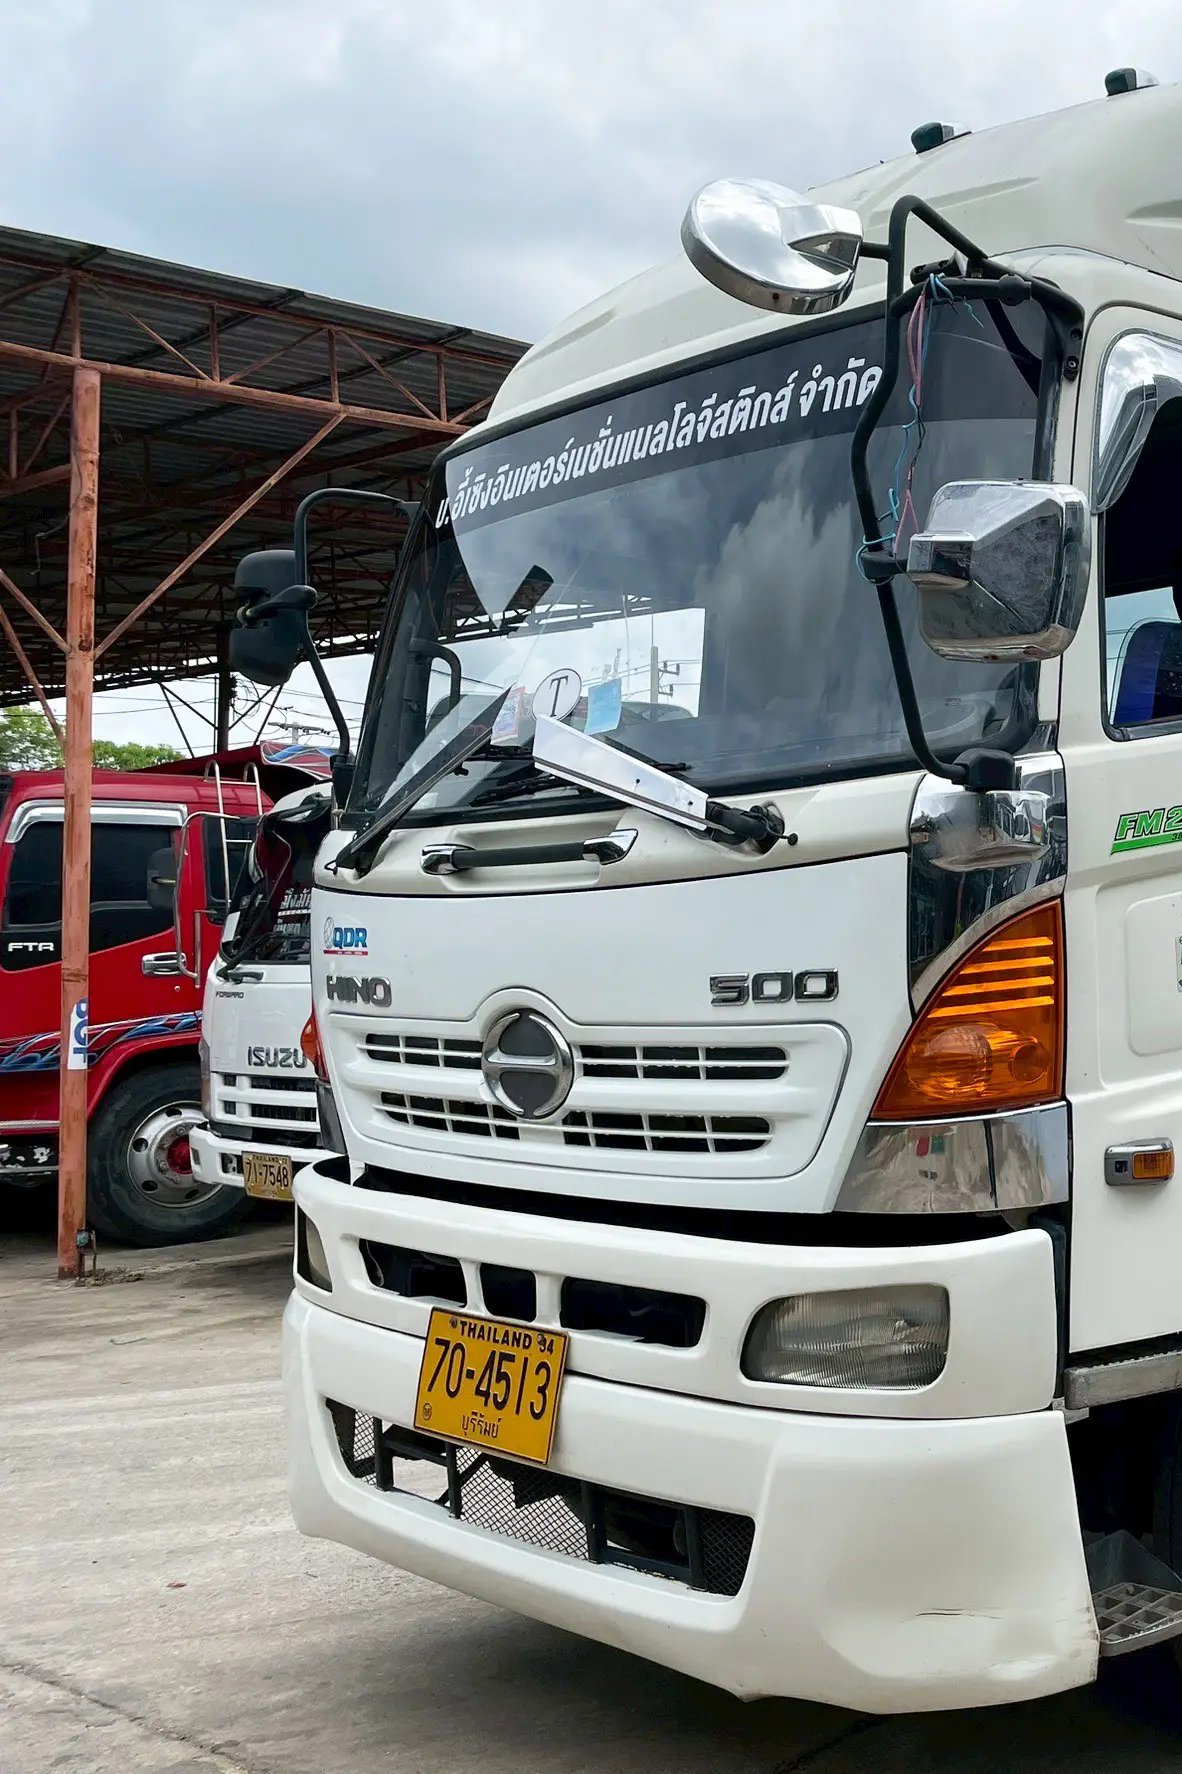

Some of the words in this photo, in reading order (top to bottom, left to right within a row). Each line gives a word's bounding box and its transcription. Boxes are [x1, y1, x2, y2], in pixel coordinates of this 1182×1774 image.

[800, 357, 884, 418] จำกัด
[549, 675, 569, 717] T
[8, 942, 54, 952] FTR
[333, 927, 368, 949] QDR
[326, 974, 392, 1008] HINO
[709, 967, 839, 1007] 500
[247, 1046, 308, 1068] ISUZU
[245, 1161, 289, 1188] 71-7548
[460, 1320, 532, 1350] THAILAND
[427, 1337, 551, 1421] 70-4513
[461, 1410, 503, 1439] บุรีรัมย์
